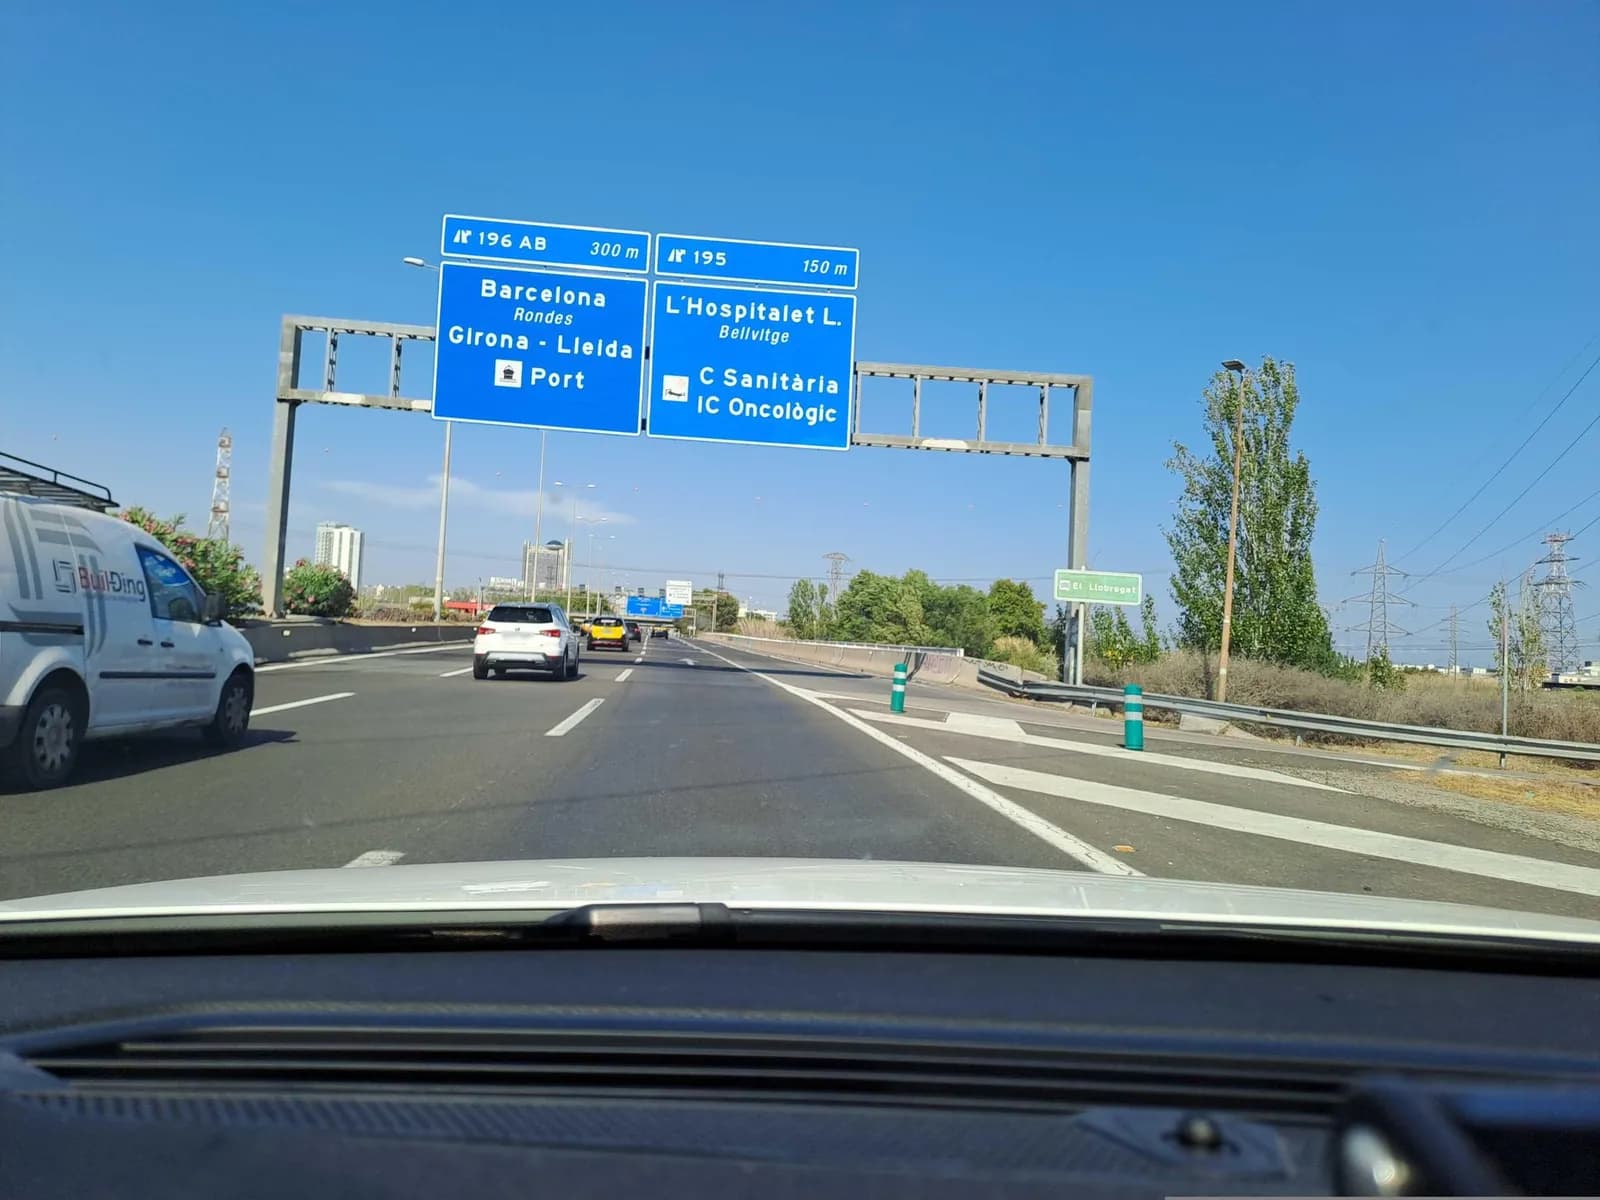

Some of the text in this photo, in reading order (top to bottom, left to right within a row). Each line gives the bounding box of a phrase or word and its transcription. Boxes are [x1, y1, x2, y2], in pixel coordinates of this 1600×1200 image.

[479, 232, 547, 251] 196 AB
[590, 242, 640, 259] 300 m
[693, 250, 727, 266] 195
[803, 259, 848, 275] 150 m
[481, 279, 606, 307] Barcelona
[514, 307, 574, 326] Rondes
[823, 307, 842, 326] L.
[448, 325, 529, 351] Girona
[557, 335, 633, 359] Lleida
[719, 325, 790, 345] Bellvitge
[530, 367, 585, 390] Port
[699, 366, 839, 394] C Sanitària
[697, 395, 838, 426] IC Oncològic
